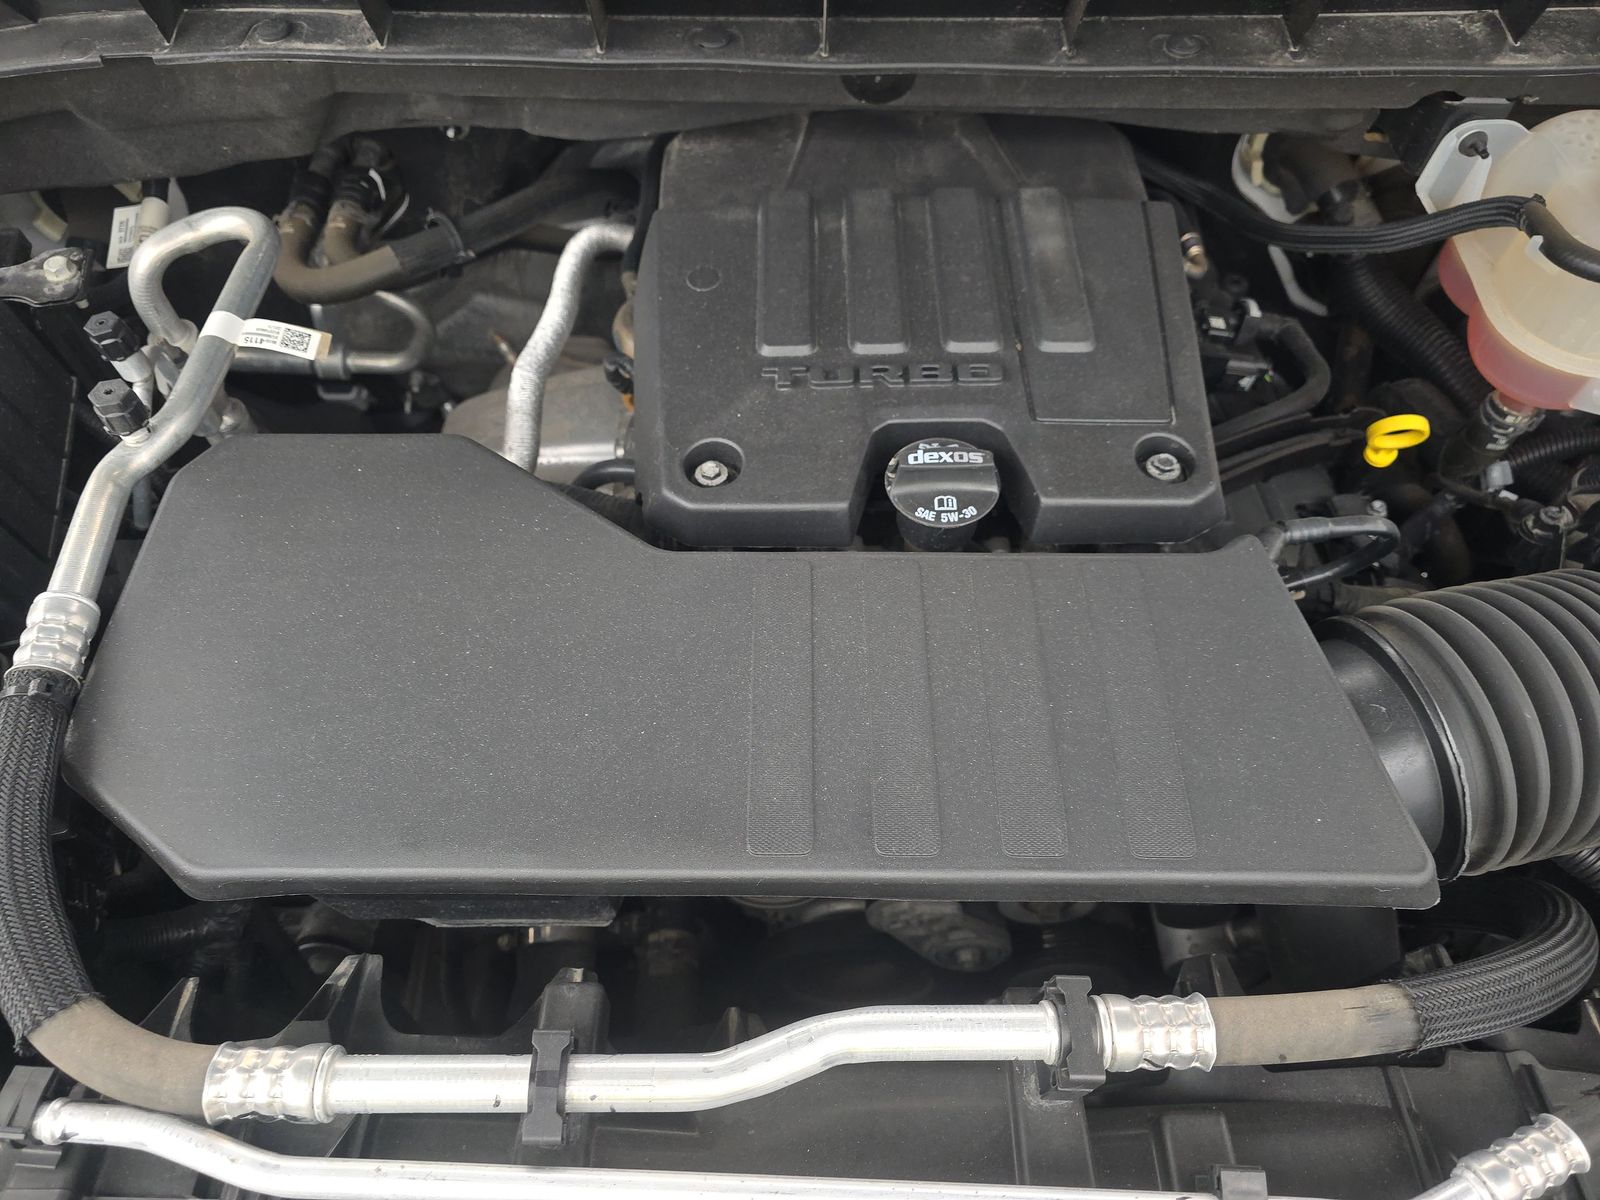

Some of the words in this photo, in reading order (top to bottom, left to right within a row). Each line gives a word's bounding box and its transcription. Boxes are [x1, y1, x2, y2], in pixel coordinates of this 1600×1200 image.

[761, 364, 1002, 390] TURBO
[907, 450, 985, 464] dexos
[914, 507, 937, 522] SAE
[940, 506, 978, 523] 5W-30
